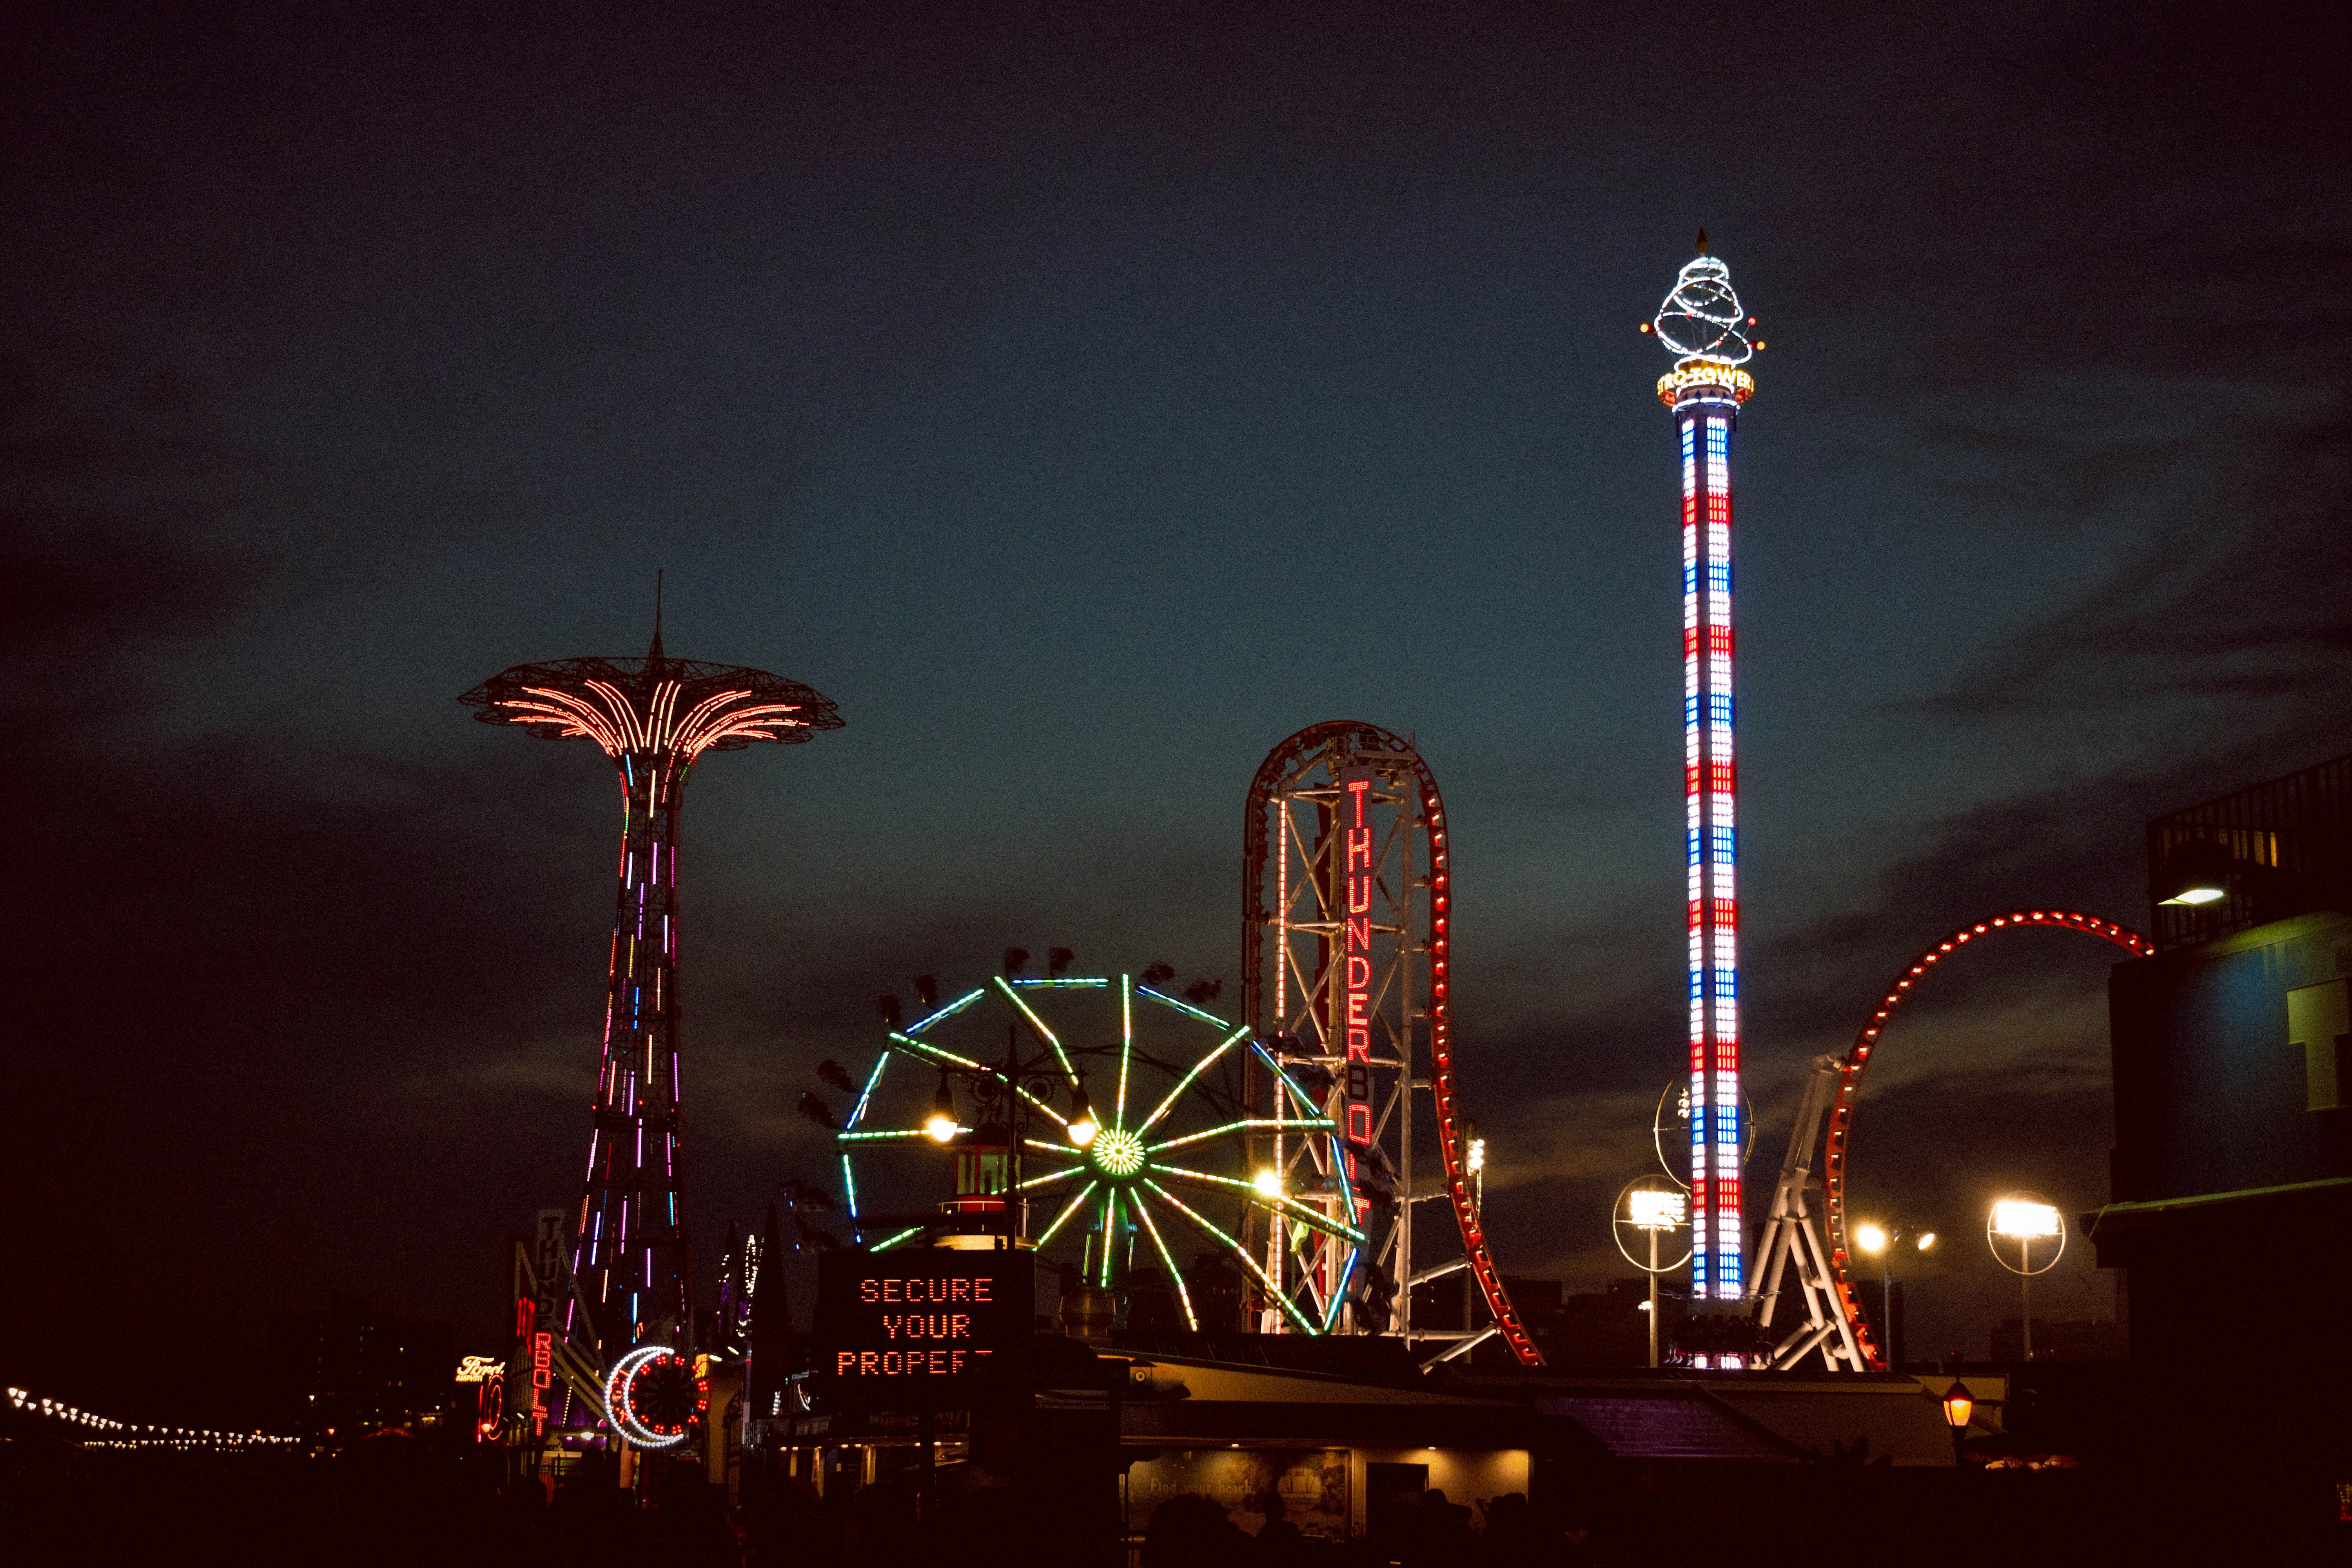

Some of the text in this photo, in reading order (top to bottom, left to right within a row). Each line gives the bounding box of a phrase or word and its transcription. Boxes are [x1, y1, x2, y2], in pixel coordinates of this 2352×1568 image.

[861, 1279, 993, 1302] SECURE
[532, 1216, 560, 1436] THUNDERBOLT
[884, 1315, 970, 1338] YOUR
[838, 1350, 993, 1375] PROPER
[1150, 1478, 1178, 1494] Find
